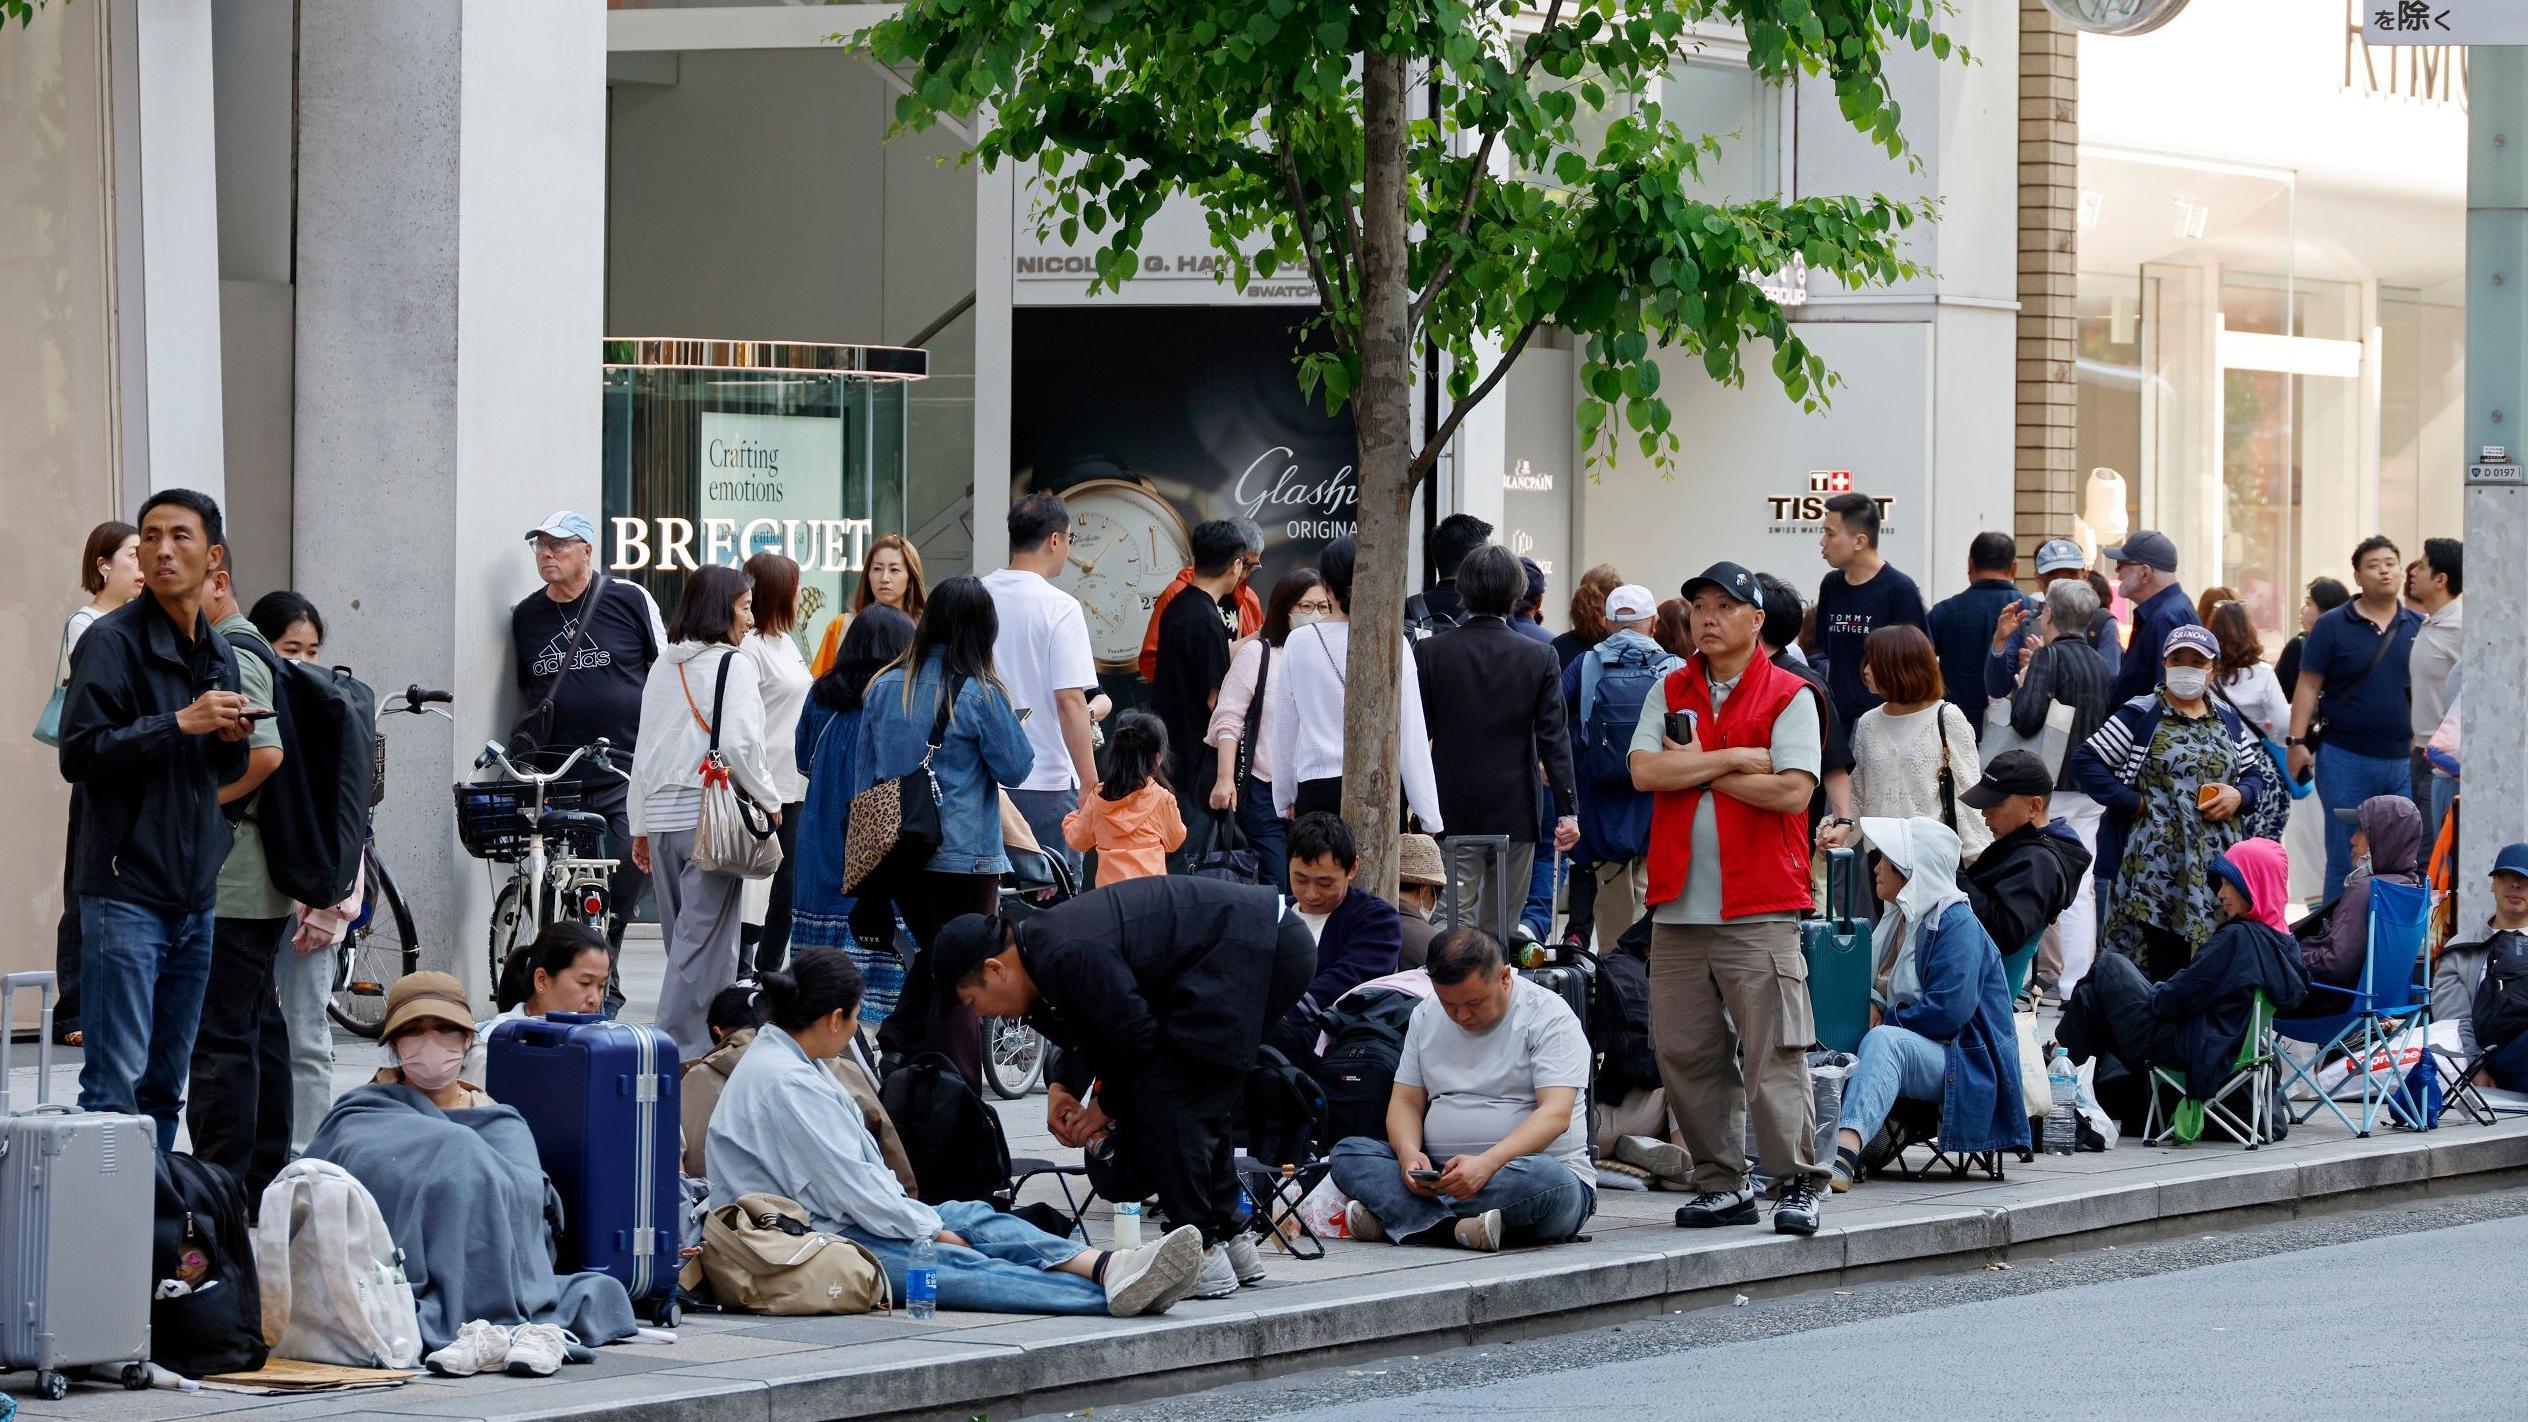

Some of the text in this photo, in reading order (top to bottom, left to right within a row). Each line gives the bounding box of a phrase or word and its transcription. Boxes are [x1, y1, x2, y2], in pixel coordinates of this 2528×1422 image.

[2374, 0, 2451, 31] を除く
[1017, 256, 1106, 272] NICOL
[1144, 255, 1170, 272] G.
[709, 438, 779, 477] Crafting
[2484, 468, 2491, 477] D
[2493, 468, 2515, 477] 0197
[709, 473, 784, 502] emotions
[1767, 496, 1894, 521] TIST
[1286, 521, 1358, 539] ORIGINA
[1768, 526, 1796, 534] SWISS
[610, 516, 873, 572] BREGUET
[1830, 614, 1872, 623] TOMMY
[1828, 625, 1870, 634] HILFIGER
[533, 650, 611, 676] addas
